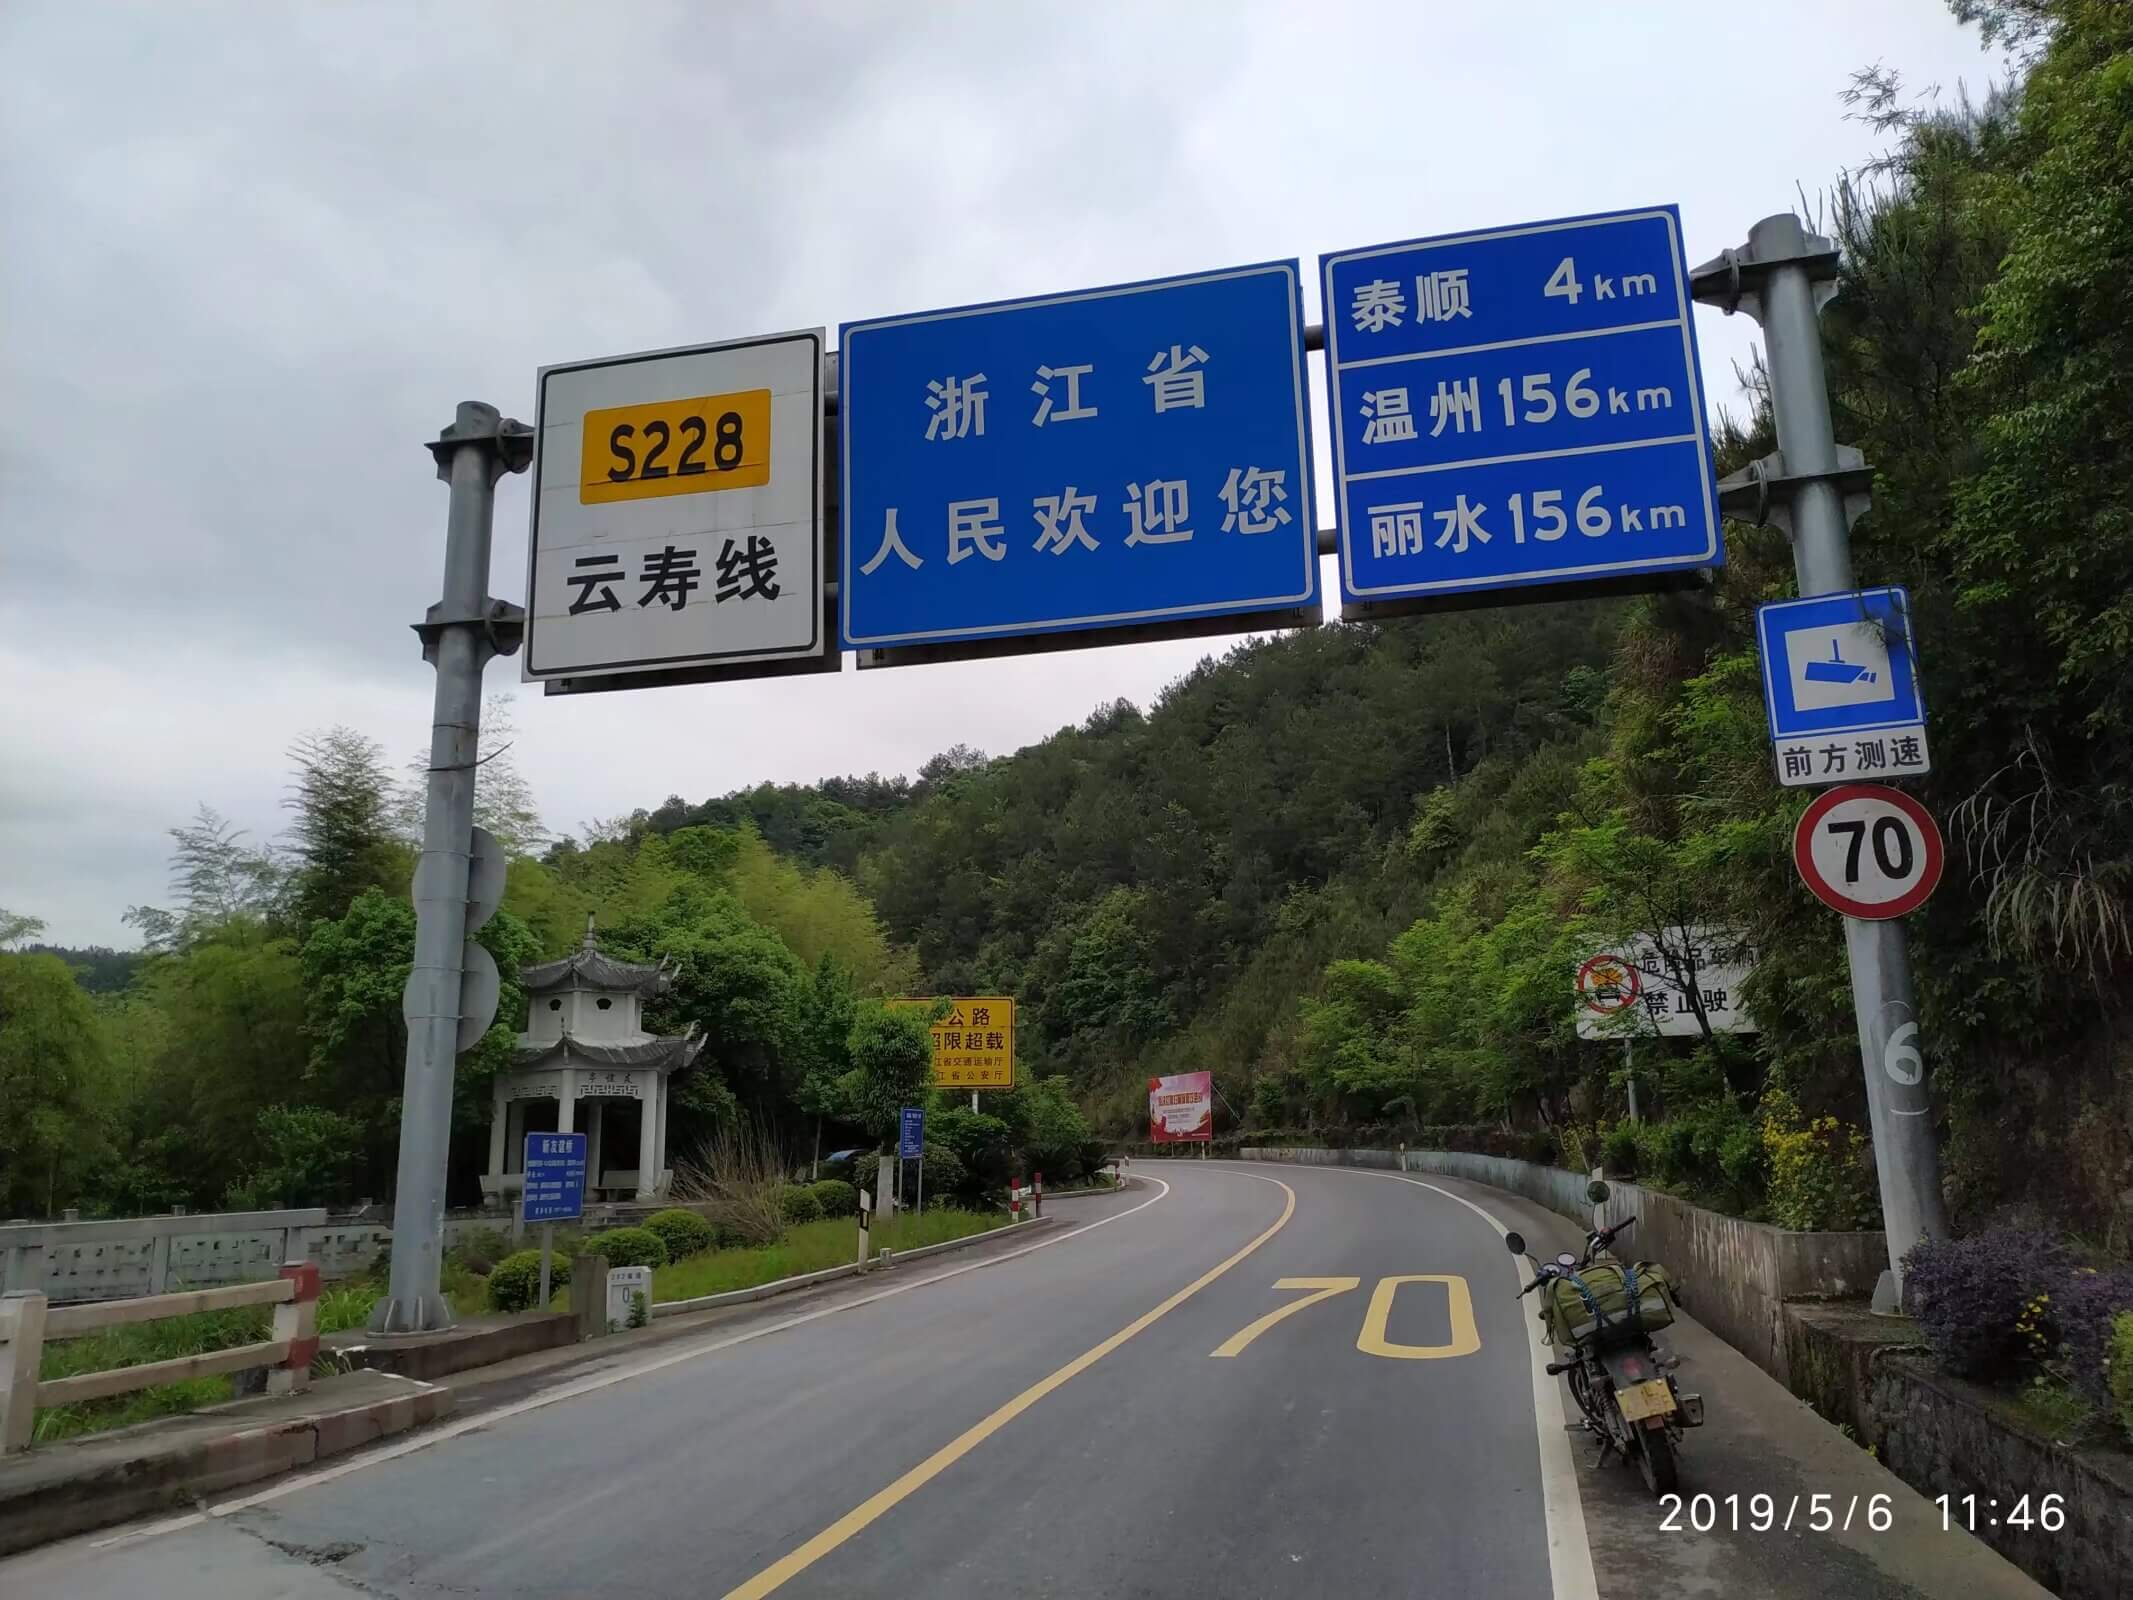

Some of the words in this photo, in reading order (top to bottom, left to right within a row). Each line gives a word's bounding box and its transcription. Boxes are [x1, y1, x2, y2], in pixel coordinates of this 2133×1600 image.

[1351, 268, 1473, 333] 泰顺
[924, 344, 1210, 441] 浙江省
[1359, 376, 1482, 446] 温州
[607, 411, 744, 484] S228
[859, 466, 1293, 576] 人民欢迎您
[1367, 494, 1493, 559] 丽水
[566, 535, 781, 617] 云寿线
[1782, 735, 1925, 779] 前方测速
[1827, 815, 1914, 883] 70
[1884, 1021, 1923, 1086] 6
[1208, 1274, 1482, 1360] 70
